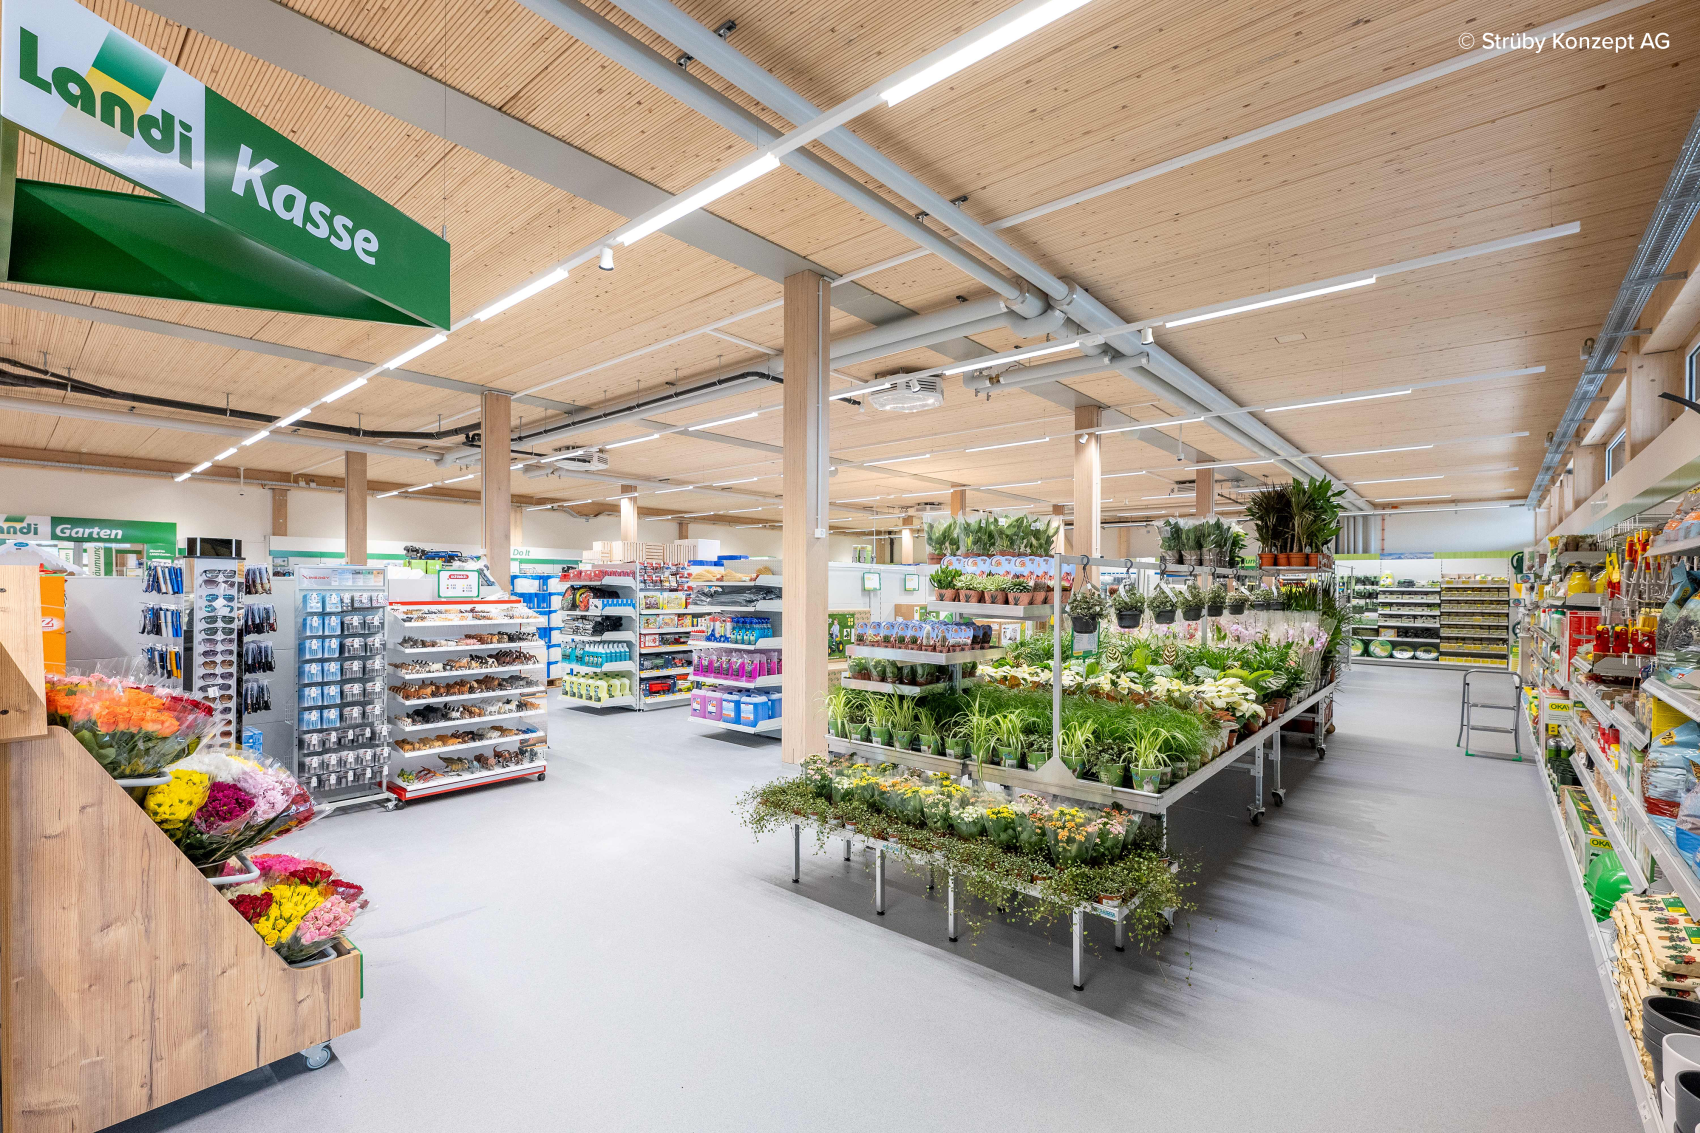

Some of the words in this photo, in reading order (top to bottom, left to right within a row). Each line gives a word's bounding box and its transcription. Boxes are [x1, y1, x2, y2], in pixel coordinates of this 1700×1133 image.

[19, 26, 193, 169] Landi
[231, 144, 379, 265] Kasse
[55, 524, 122, 539] Garten
[513, 549, 523, 557] Do
[525, 549, 531, 557] It
[1591, 839, 1613, 848] OKA
